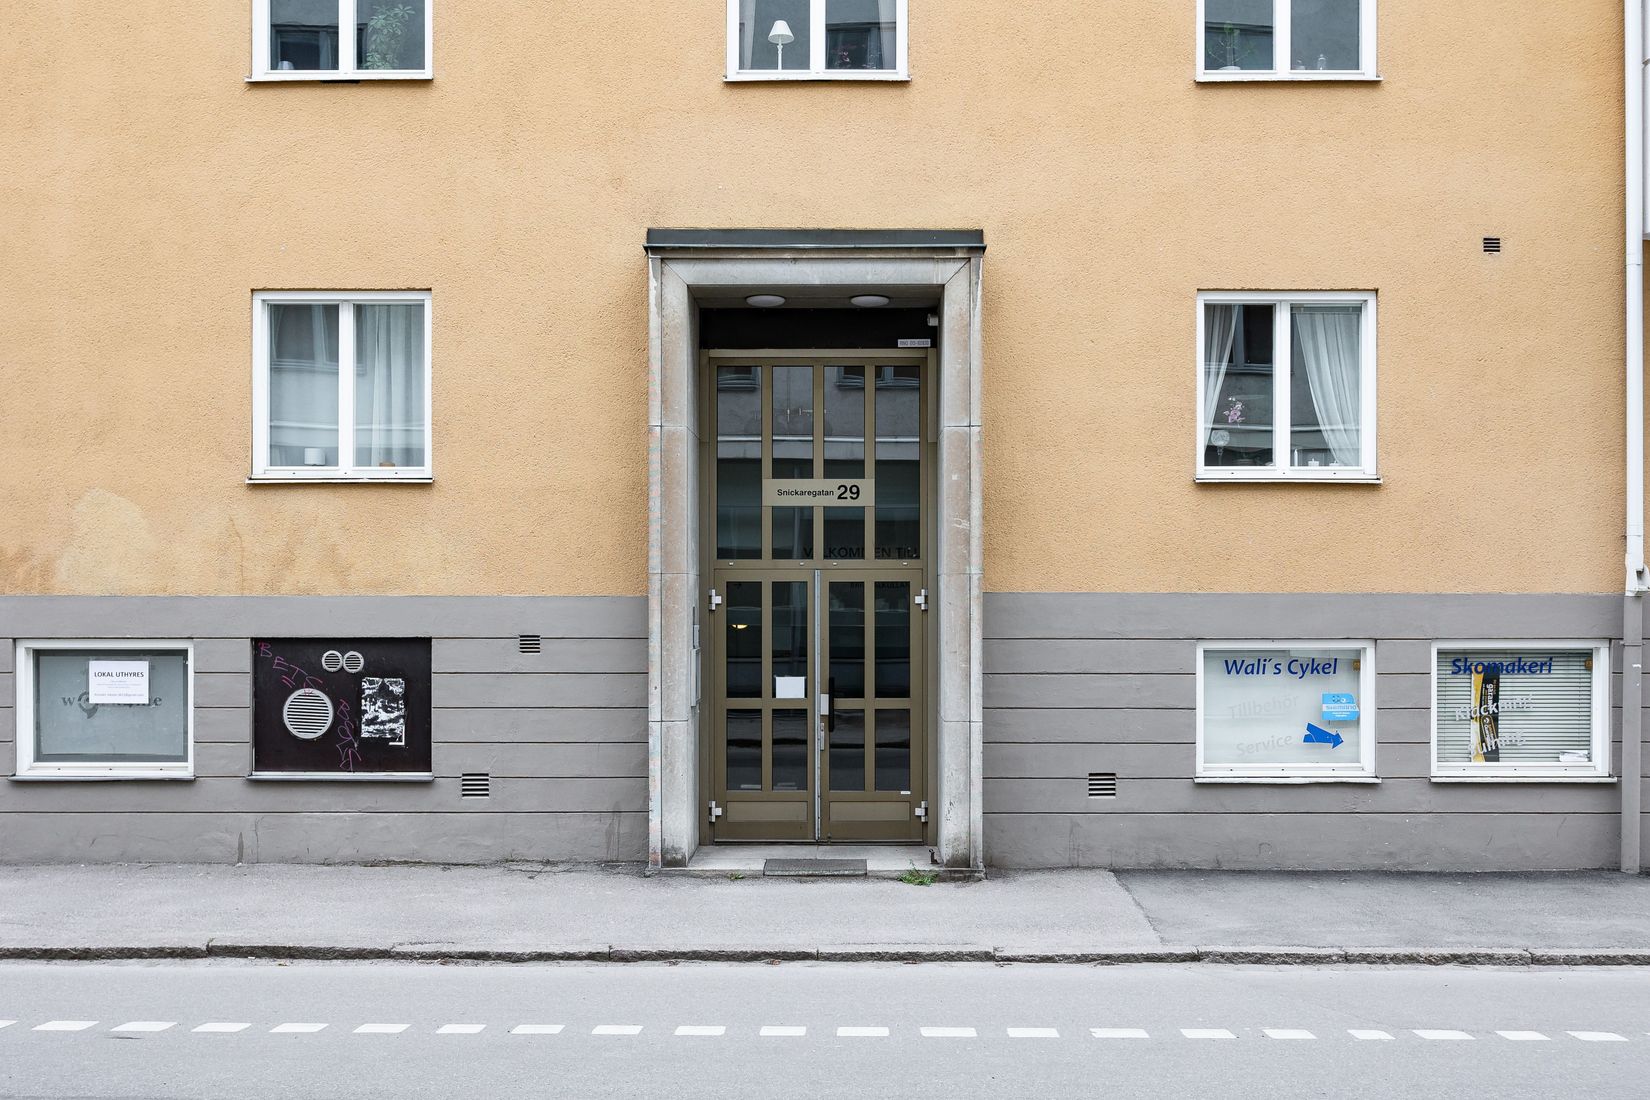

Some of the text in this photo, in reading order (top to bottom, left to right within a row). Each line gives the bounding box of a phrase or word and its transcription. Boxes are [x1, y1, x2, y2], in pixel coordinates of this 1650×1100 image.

[777, 484, 860, 500] Snickaregatan 29
[803, 547, 891, 558] VLKOMEN
[1287, 657, 1338, 679] Cykel
[1451, 656, 1553, 675] Skomakeri
[1228, 694, 1299, 720] Tillbehör
[1236, 733, 1293, 757] Service
